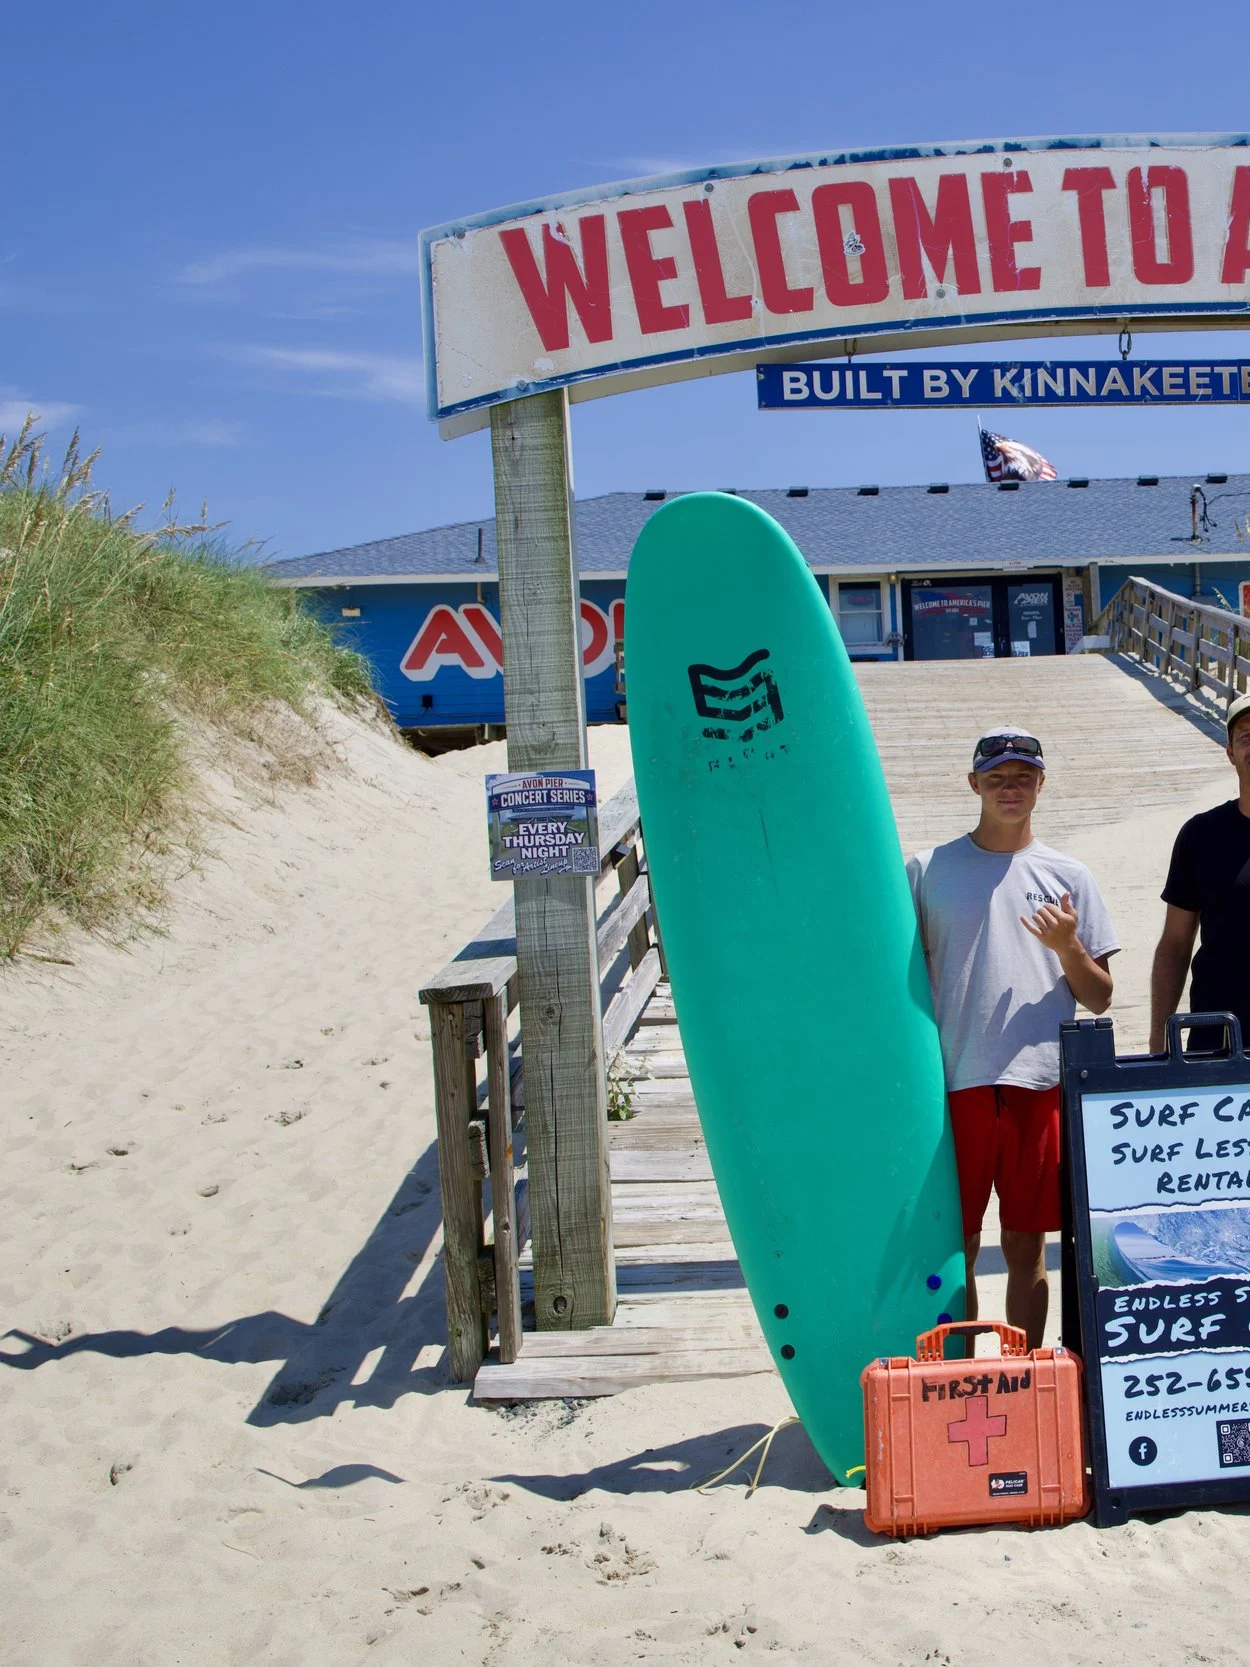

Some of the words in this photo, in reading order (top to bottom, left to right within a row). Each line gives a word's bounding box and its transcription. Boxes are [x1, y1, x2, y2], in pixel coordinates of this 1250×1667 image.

[498, 169, 1042, 352] WELCOME
[1062, 165, 1195, 288] TO
[782, 369, 908, 401] BUILT
[923, 368, 979, 399] BY
[1014, 592, 1049, 605] AVON
[522, 779, 544, 790] AVON
[545, 778, 564, 789] PIER
[500, 790, 549, 808] CONCERT
[550, 789, 586, 804] SERIES
[518, 821, 568, 835] EVERY
[502, 832, 585, 848] THURSDAY
[521, 845, 570, 859] NIGHT
[494, 857, 515, 871] Scan
[511, 861, 525, 875] for
[522, 856, 548, 875] Artist
[540, 858, 568, 875] Lineup
[1109, 1101, 1200, 1130] SURF
[1111, 1142, 1184, 1165] SURF
[1113, 1291, 1223, 1313] ENDLESS
[1104, 1313, 1227, 1348] SURF
